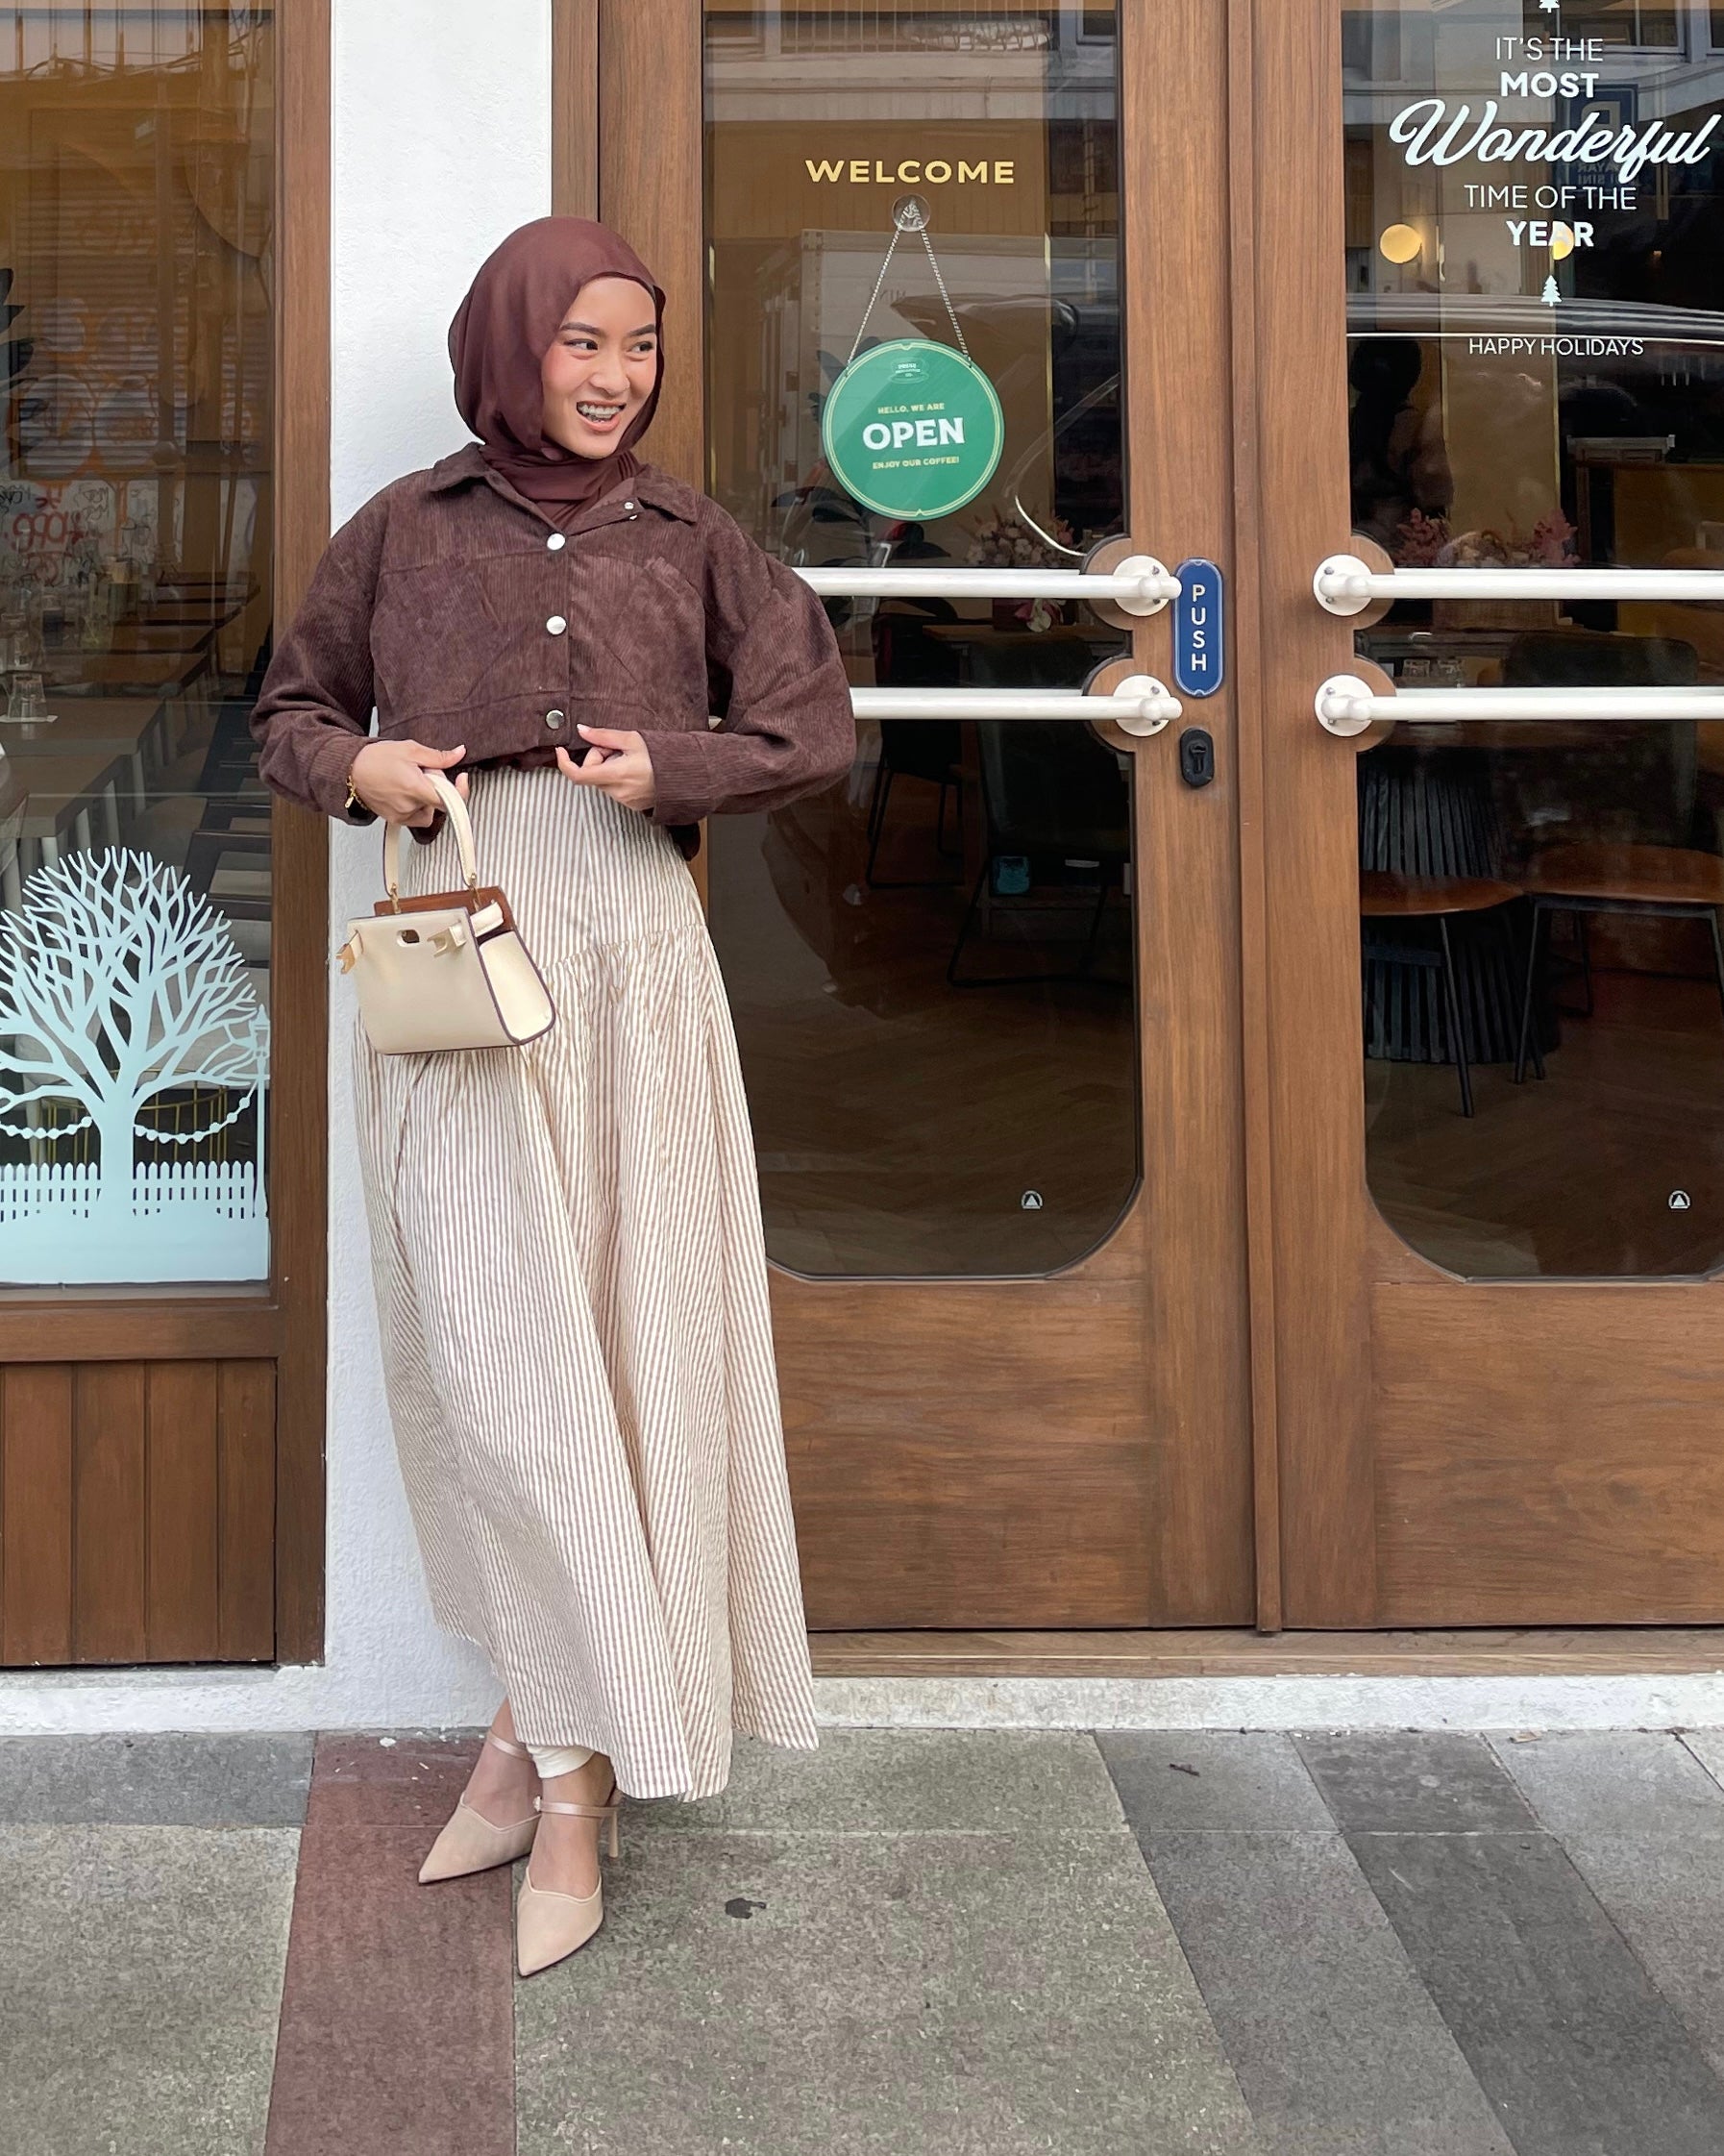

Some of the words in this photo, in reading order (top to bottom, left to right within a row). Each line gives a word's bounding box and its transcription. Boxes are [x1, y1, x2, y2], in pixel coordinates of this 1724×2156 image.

[1495, 37, 1543, 61] IT'S
[1553, 37, 1604, 62] THE
[1500, 71, 1599, 98] MOST
[1389, 99, 1722, 184] Wonderful
[804, 160, 1015, 184] WELCOME
[1464, 185, 1528, 209] TIME
[1535, 186, 1577, 209] OF
[1582, 186, 1638, 211] THE
[1505, 220, 1594, 247] YEAR
[1469, 337, 1537, 356] HAPPY
[1540, 337, 1644, 356] HOLIDAYS
[910, 404, 924, 412] WE
[926, 402, 945, 411] ARE
[862, 417, 965, 450] OPEN
[872, 460, 900, 470] ENJOY
[901, 458, 922, 467] OUR
[1191, 583, 1207, 672] PUSH
